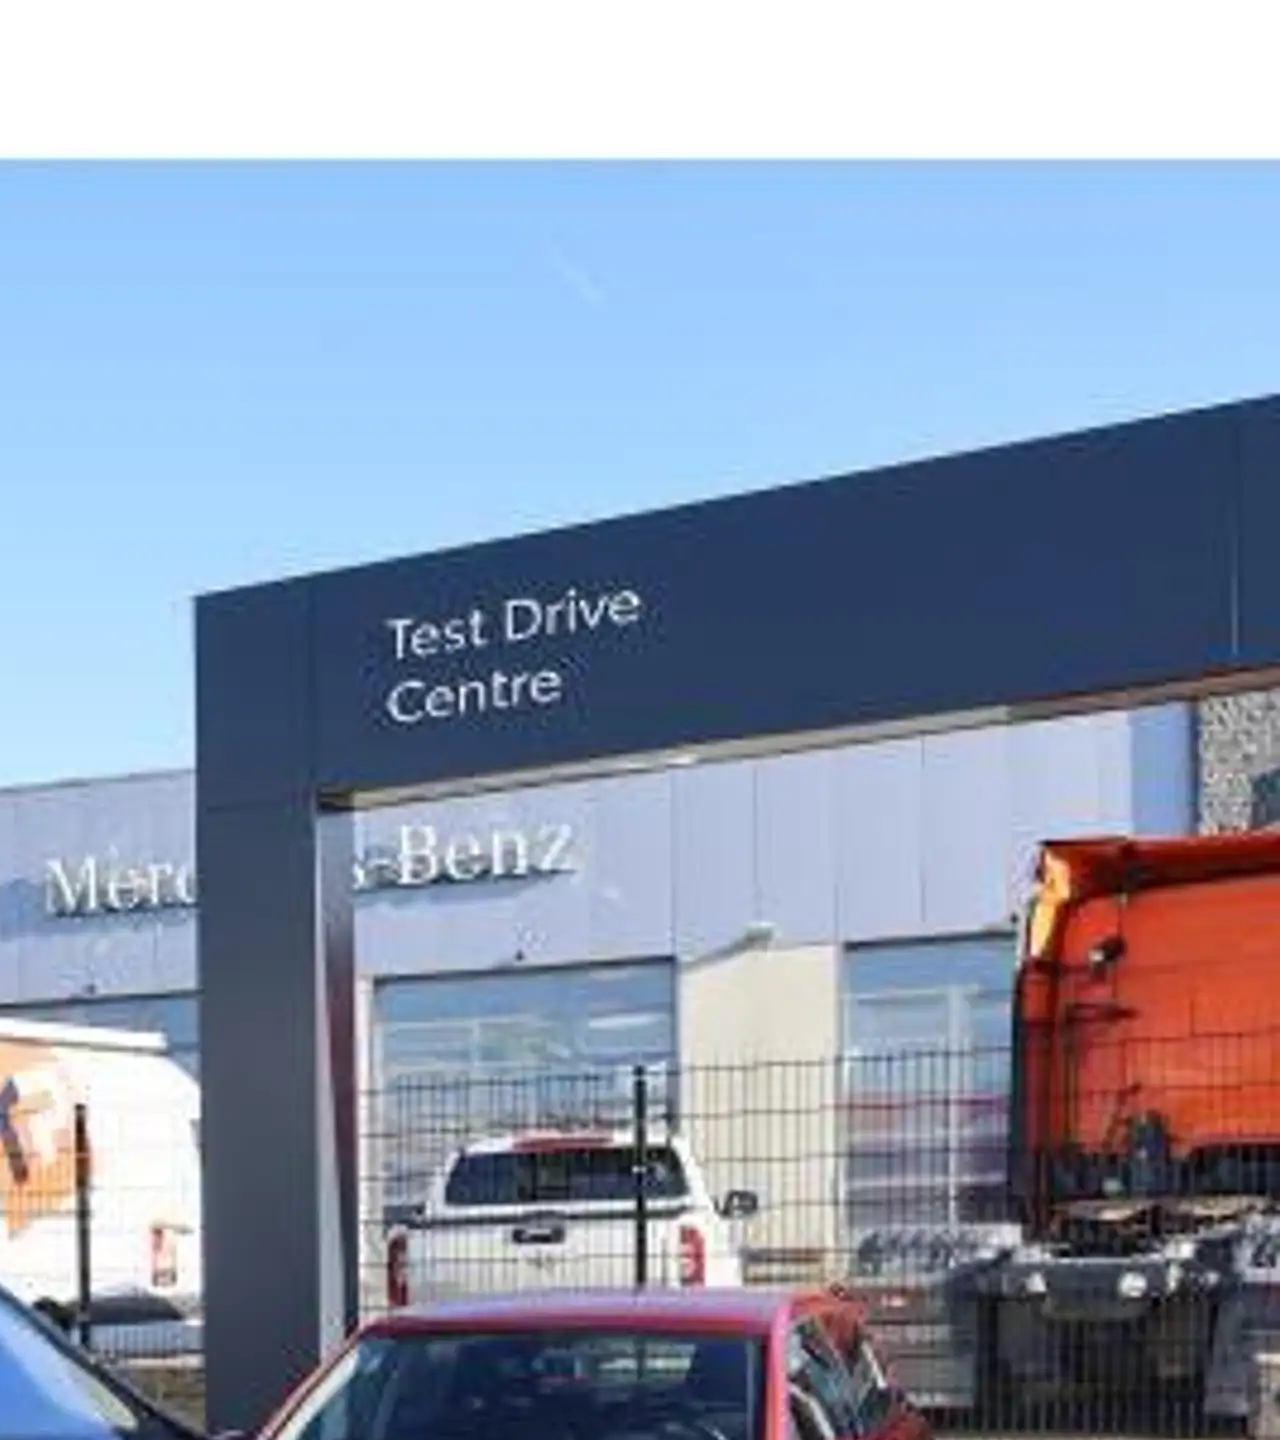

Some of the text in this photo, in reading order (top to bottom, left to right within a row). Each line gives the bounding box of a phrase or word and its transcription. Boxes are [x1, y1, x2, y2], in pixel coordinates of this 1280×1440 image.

[386, 587, 641, 660] Test Drive
[387, 669, 562, 723] Centre
